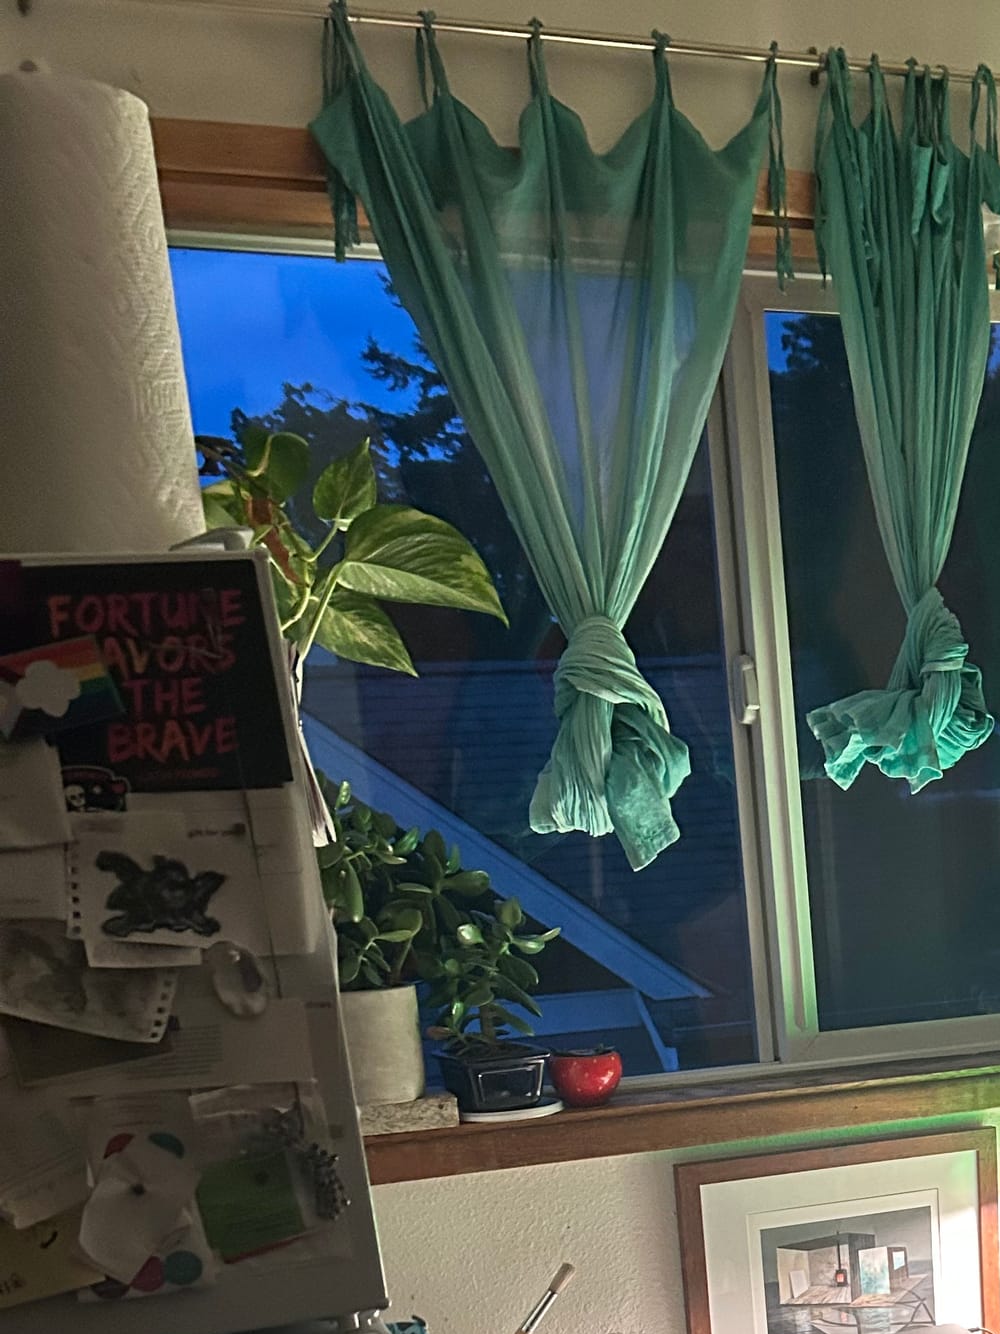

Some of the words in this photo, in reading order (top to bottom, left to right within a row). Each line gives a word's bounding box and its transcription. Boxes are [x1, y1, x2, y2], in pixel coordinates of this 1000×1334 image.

[103, 634, 237, 681] AVORS
[121, 676, 208, 718] THE
[106, 715, 240, 764] BRAVE
